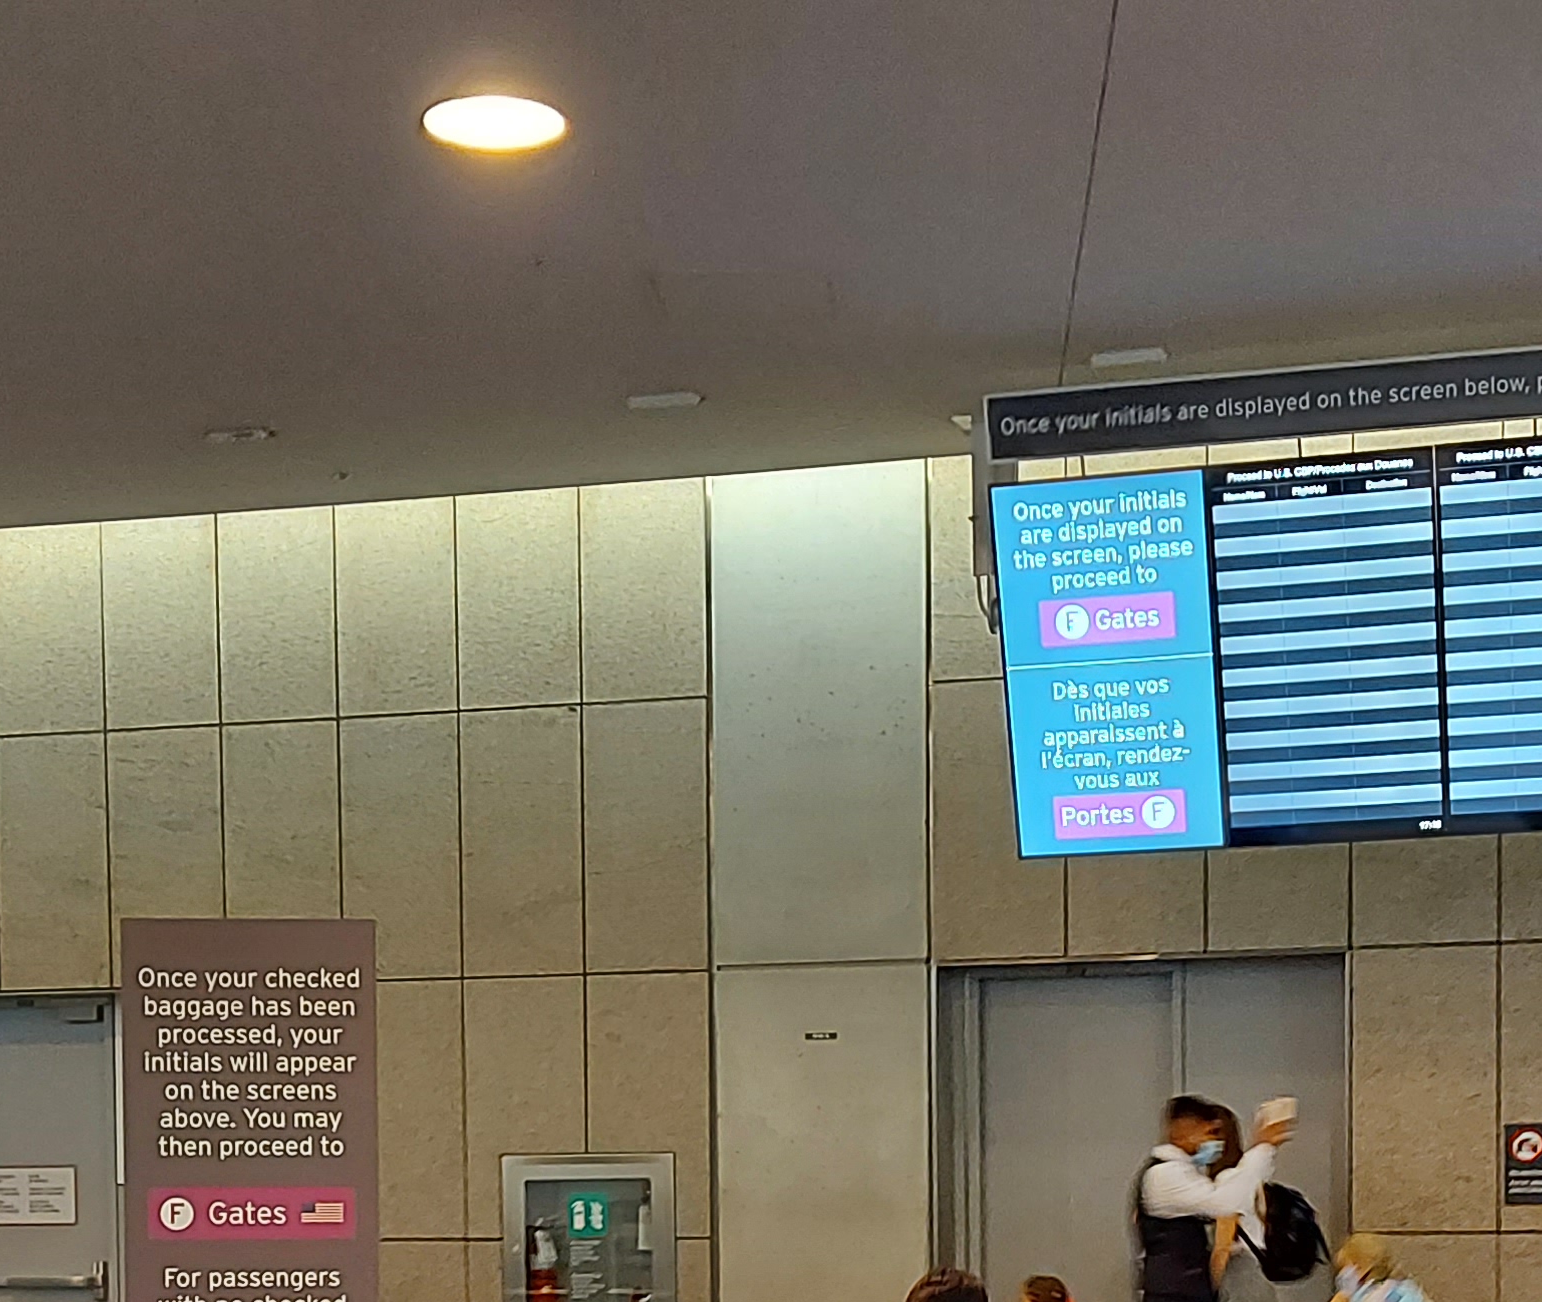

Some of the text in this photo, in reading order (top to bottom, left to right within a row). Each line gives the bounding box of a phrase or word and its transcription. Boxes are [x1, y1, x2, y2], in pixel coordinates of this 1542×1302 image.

[1000, 416, 1051, 436] Once
[1054, 412, 1101, 436] your
[1105, 403, 1172, 428] initials
[1176, 404, 1209, 421] are
[1215, 391, 1310, 420] displayed
[1317, 392, 1342, 409] on
[1348, 387, 1382, 407] the
[1389, 382, 1458, 403] screen
[1464, 375, 1530, 396] below,
[1013, 489, 1187, 522] Once your initials
[1020, 515, 1183, 545] are displayed on
[1013, 540, 1194, 570] the screen, please
[1051, 564, 1157, 595] proceed to
[1095, 607, 1160, 631] Gates
[1052, 678, 1169, 701] Dès que vos
[1073, 701, 1150, 722] initiales
[1043, 719, 1185, 749] apparaissent à
[1041, 743, 1190, 770] l'écran, rendez-
[1073, 771, 1160, 790] vous aux
[1061, 803, 1134, 827] Portes
[138, 967, 360, 993] Once your checked
[144, 995, 355, 1021] baggage has been
[158, 1023, 343, 1049] processed, your
[144, 1051, 357, 1077] initials will appear
[164, 1079, 337, 1101] on the screens
[160, 1107, 343, 1133] above. You may
[158, 1135, 344, 1161] then proceed to
[208, 1201, 287, 1225] Gates
[164, 1267, 341, 1292] For passengers
